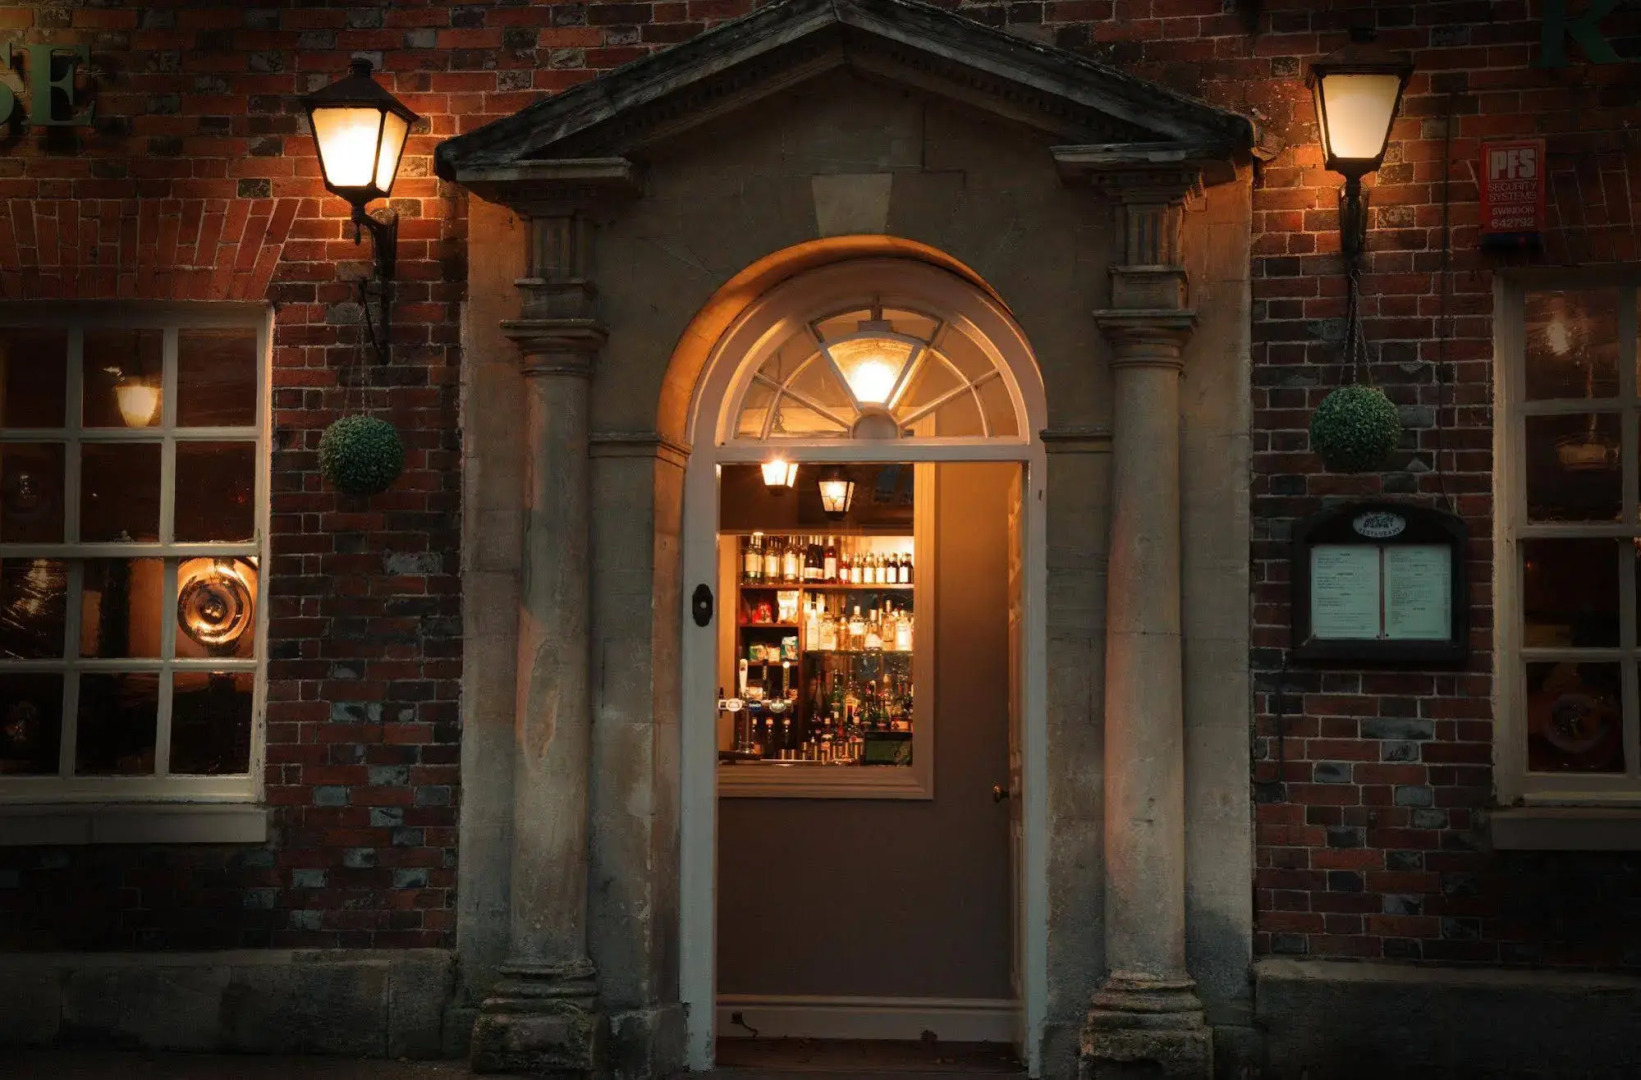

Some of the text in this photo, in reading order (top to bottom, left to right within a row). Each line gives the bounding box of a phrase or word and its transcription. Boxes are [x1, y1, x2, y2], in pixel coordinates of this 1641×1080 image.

[1490, 149, 1535, 179] PFS
[1487, 182, 1537, 192] SECURITY
[1488, 191, 1537, 202] SYSTEMS
